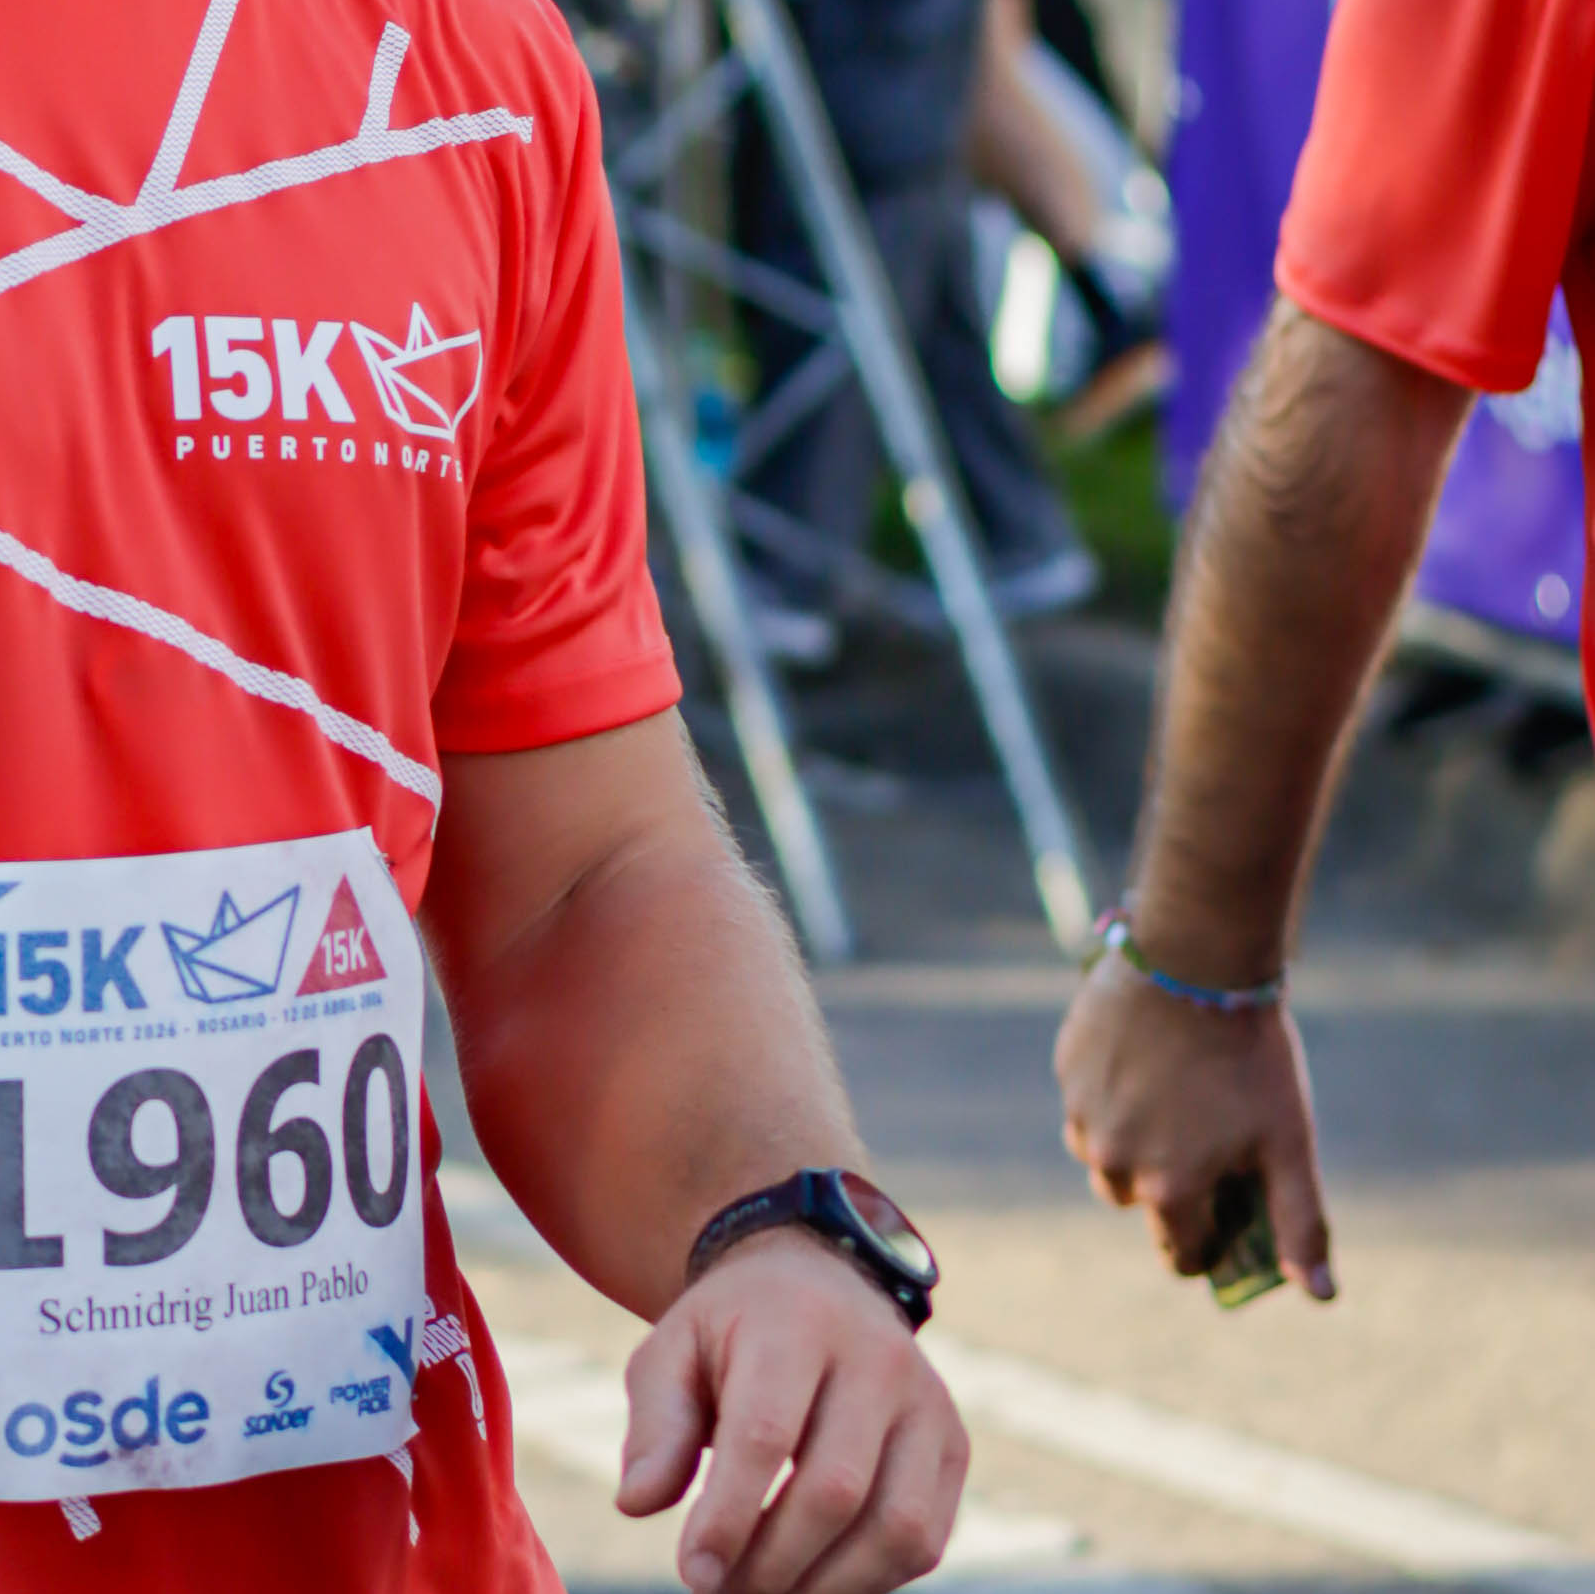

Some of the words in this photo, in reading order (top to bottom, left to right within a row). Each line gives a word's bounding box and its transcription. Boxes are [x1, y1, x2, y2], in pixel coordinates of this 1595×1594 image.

[151, 315, 356, 424] 15K
[175, 434, 357, 463] PUERTO
[374, 442, 464, 483] NORTE
[320, 925, 369, 977] 15K
[60, 1025, 125, 1045] NORTE
[197, 1011, 267, 1034] ROSARIO
[38, 1287, 213, 1335] Schnidrig
[223, 1282, 290, 1319] Juan
[300, 1261, 369, 1307] Pablo
[329, 1375, 391, 1404] POWER
[4, 1374, 210, 1463] osde
